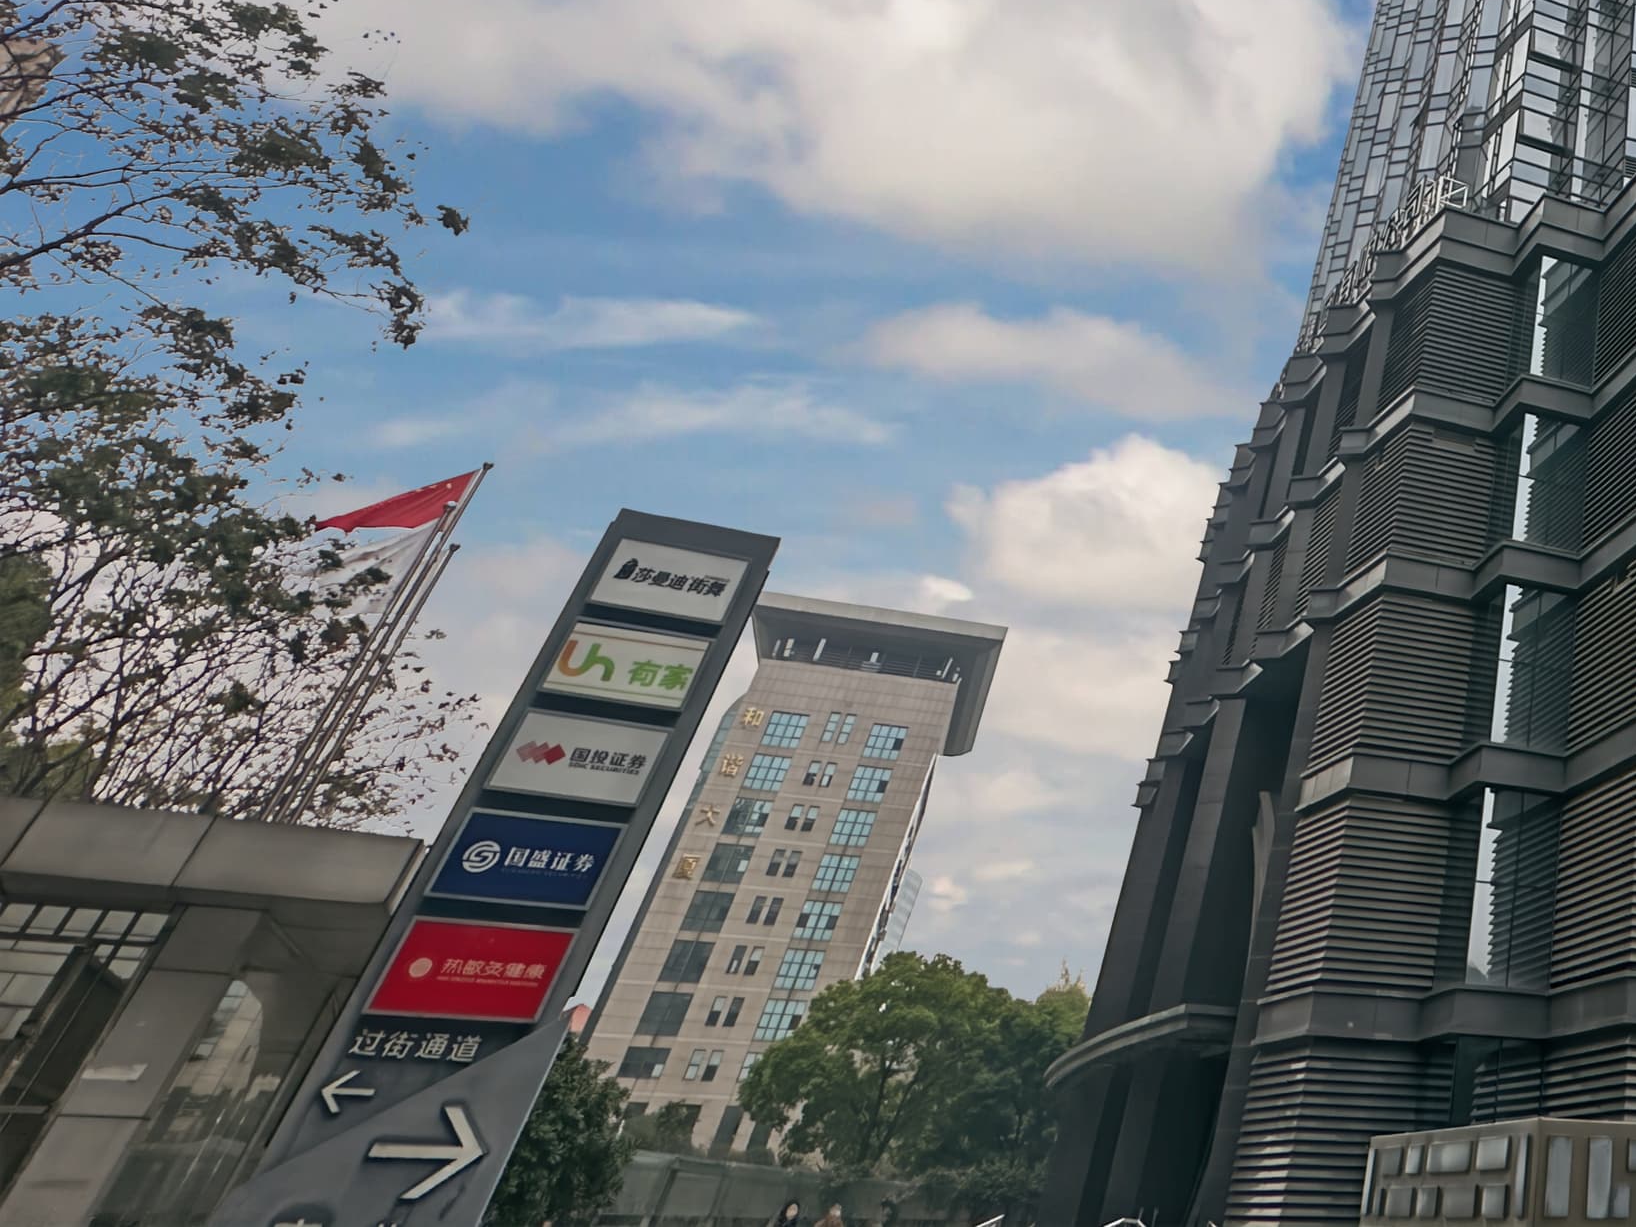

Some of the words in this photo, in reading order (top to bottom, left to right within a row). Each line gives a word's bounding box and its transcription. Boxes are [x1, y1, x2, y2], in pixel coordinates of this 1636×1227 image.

[630, 567, 728, 597] 莎曼迪街舞
[569, 747, 648, 770] 国投证券
[671, 706, 765, 880] 和谐大厦
[503, 846, 596, 873] 国盛证券
[348, 1028, 483, 1063] 过街通道
